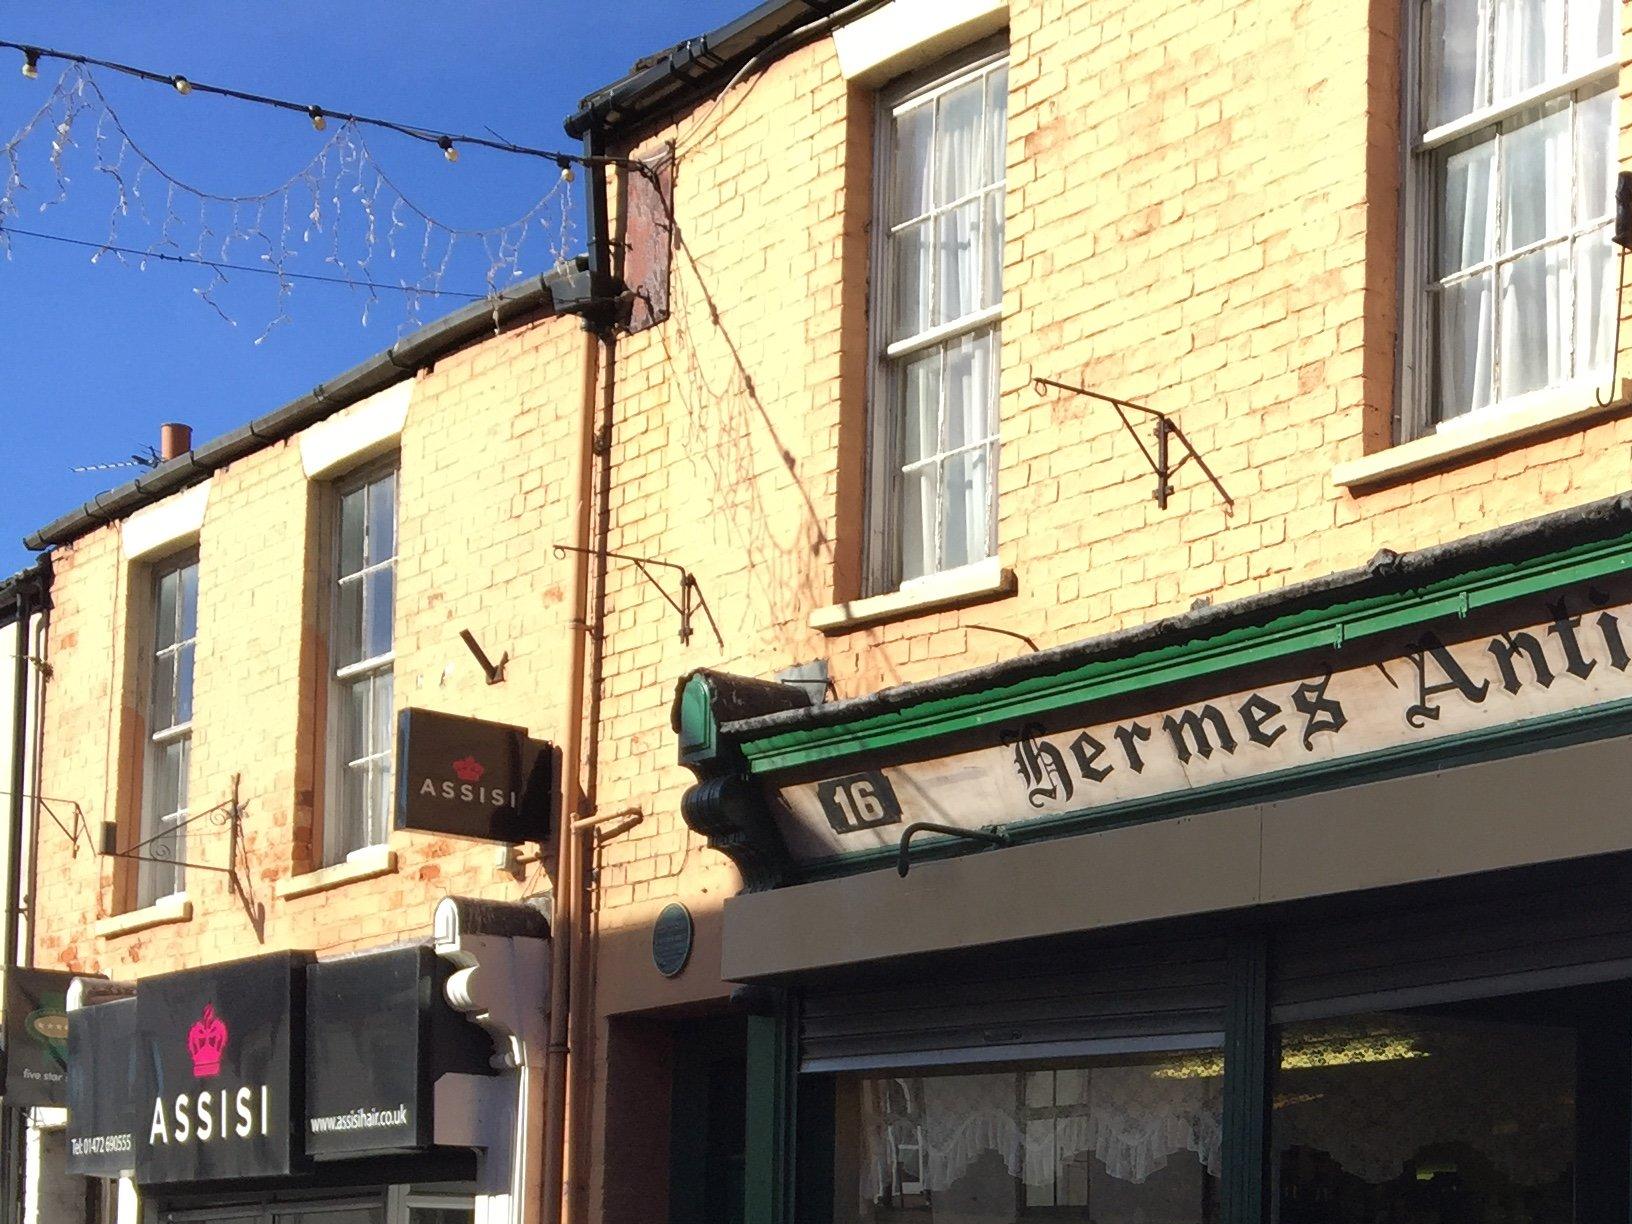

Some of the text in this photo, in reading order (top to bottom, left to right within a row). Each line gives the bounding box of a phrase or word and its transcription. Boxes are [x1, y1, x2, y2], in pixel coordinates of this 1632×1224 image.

[1002, 663, 1348, 808] Hermes
[420, 778, 516, 809] ASSISI
[833, 780, 884, 826] 16
[150, 1085, 269, 1146] ASSISI
[311, 1103, 408, 1136] www.assisihair.co.uk
